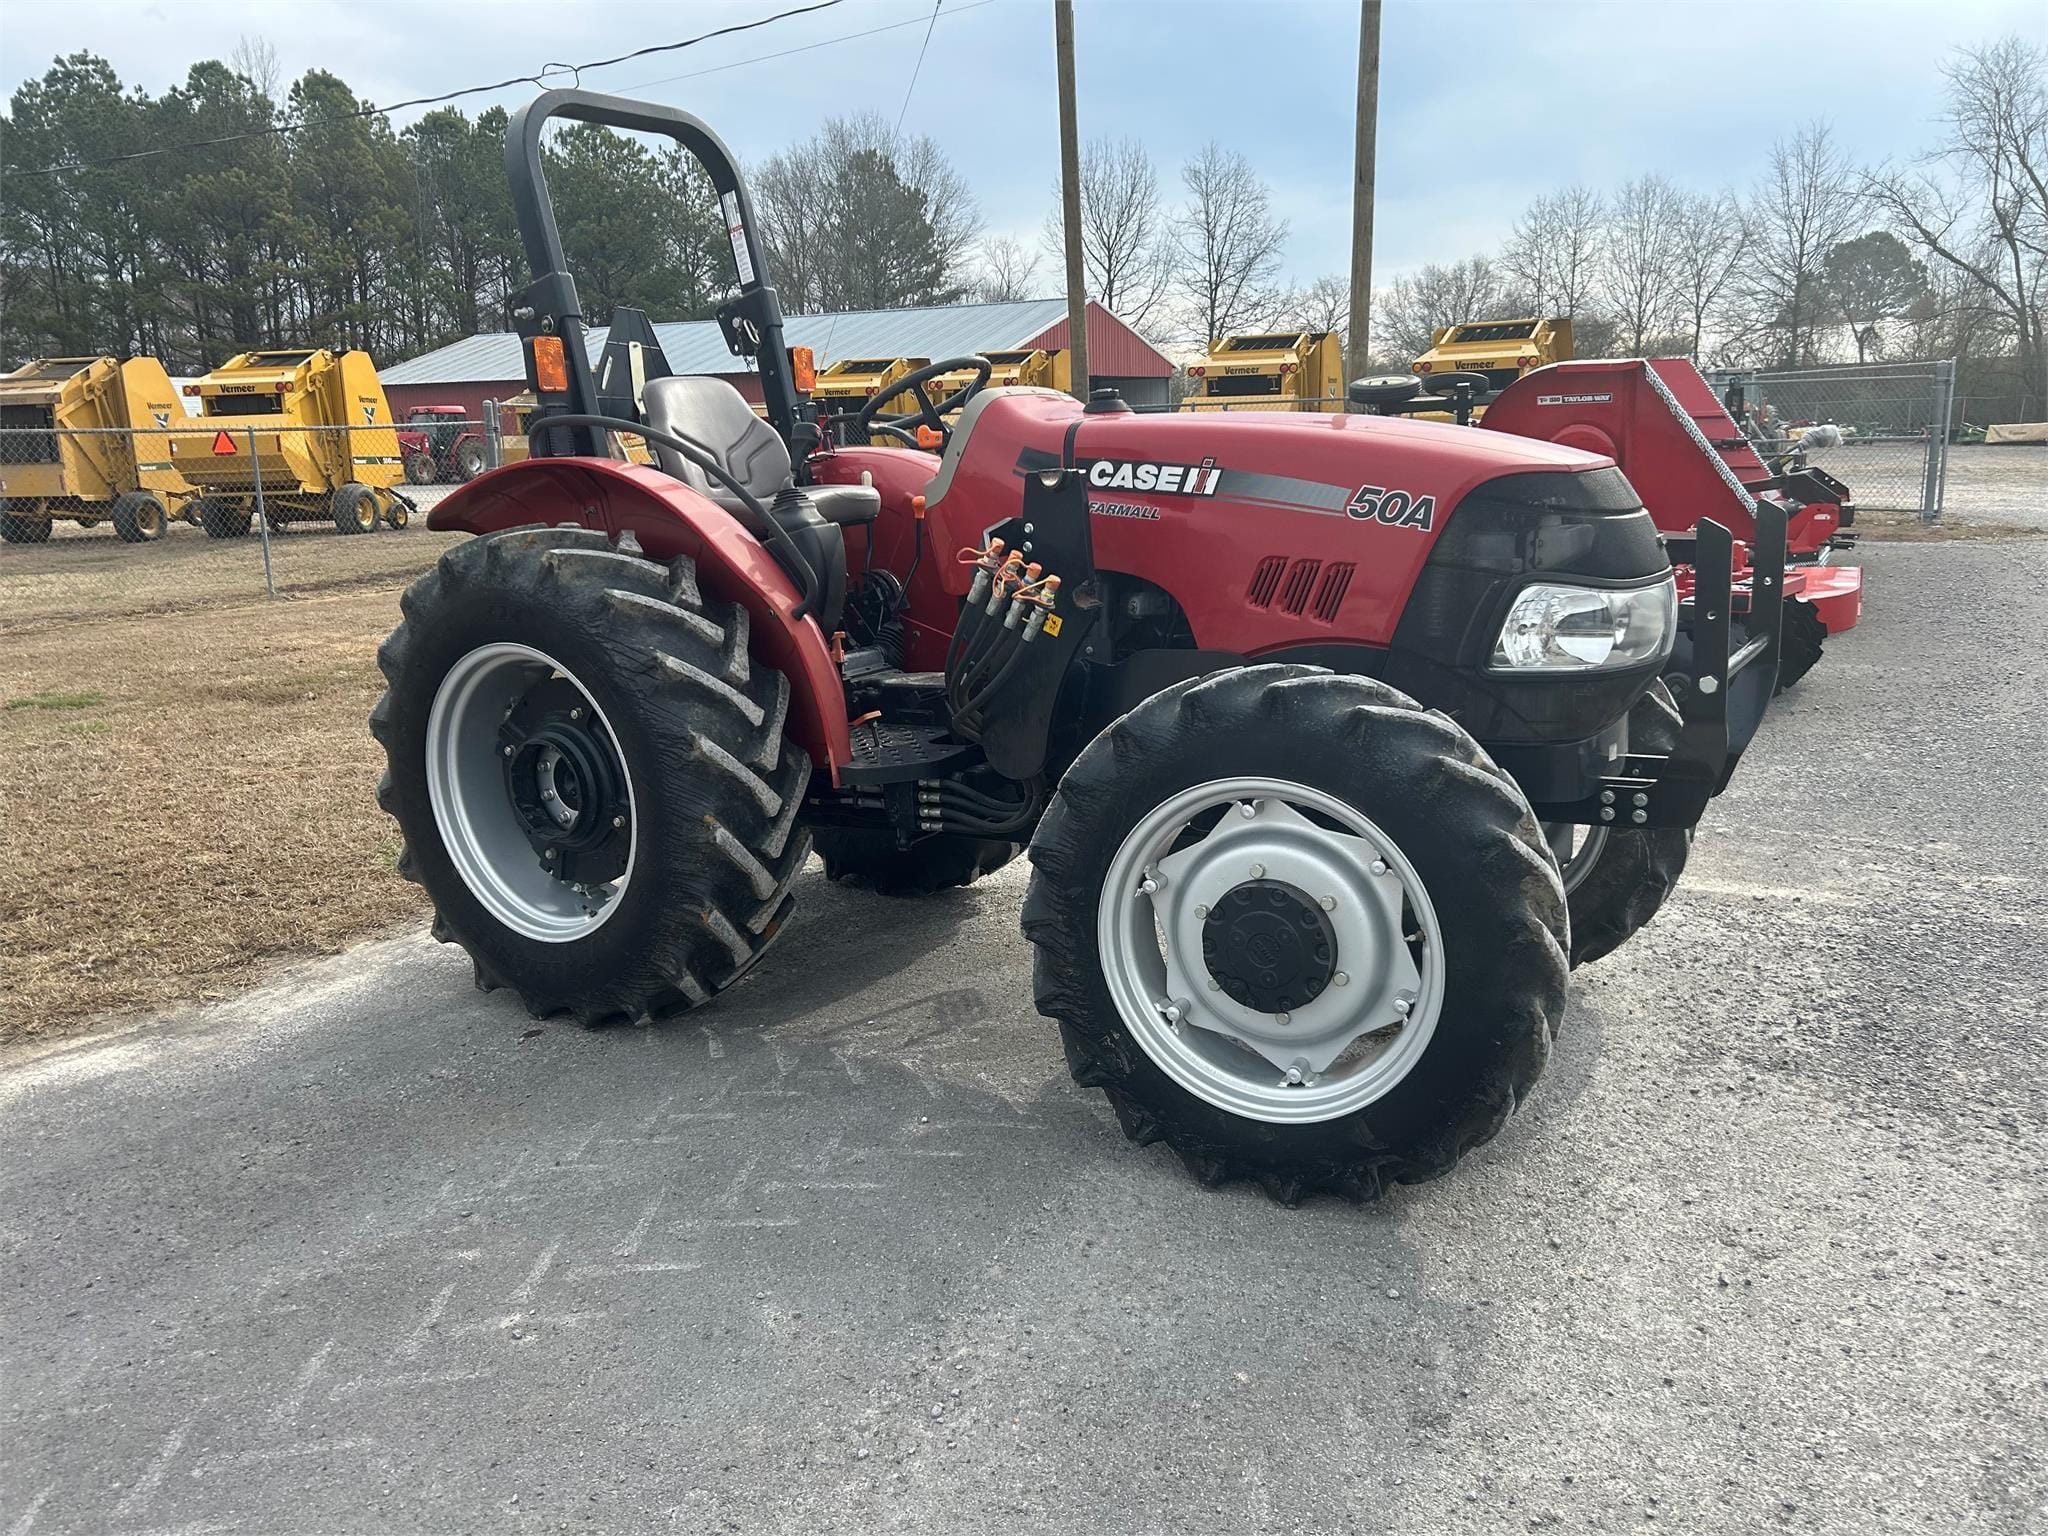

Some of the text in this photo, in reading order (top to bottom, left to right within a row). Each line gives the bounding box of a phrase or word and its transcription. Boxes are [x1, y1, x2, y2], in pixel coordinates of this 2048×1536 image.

[1455, 361, 1495, 370] Vermeer
[1224, 366, 1259, 375] Vermeer
[219, 384, 256, 393] Vermeer
[824, 388, 851, 396] Vermeer
[1089, 460, 1185, 492] CASE
[1088, 502, 1160, 520] FARMALL
[1347, 484, 1437, 532] 50A
